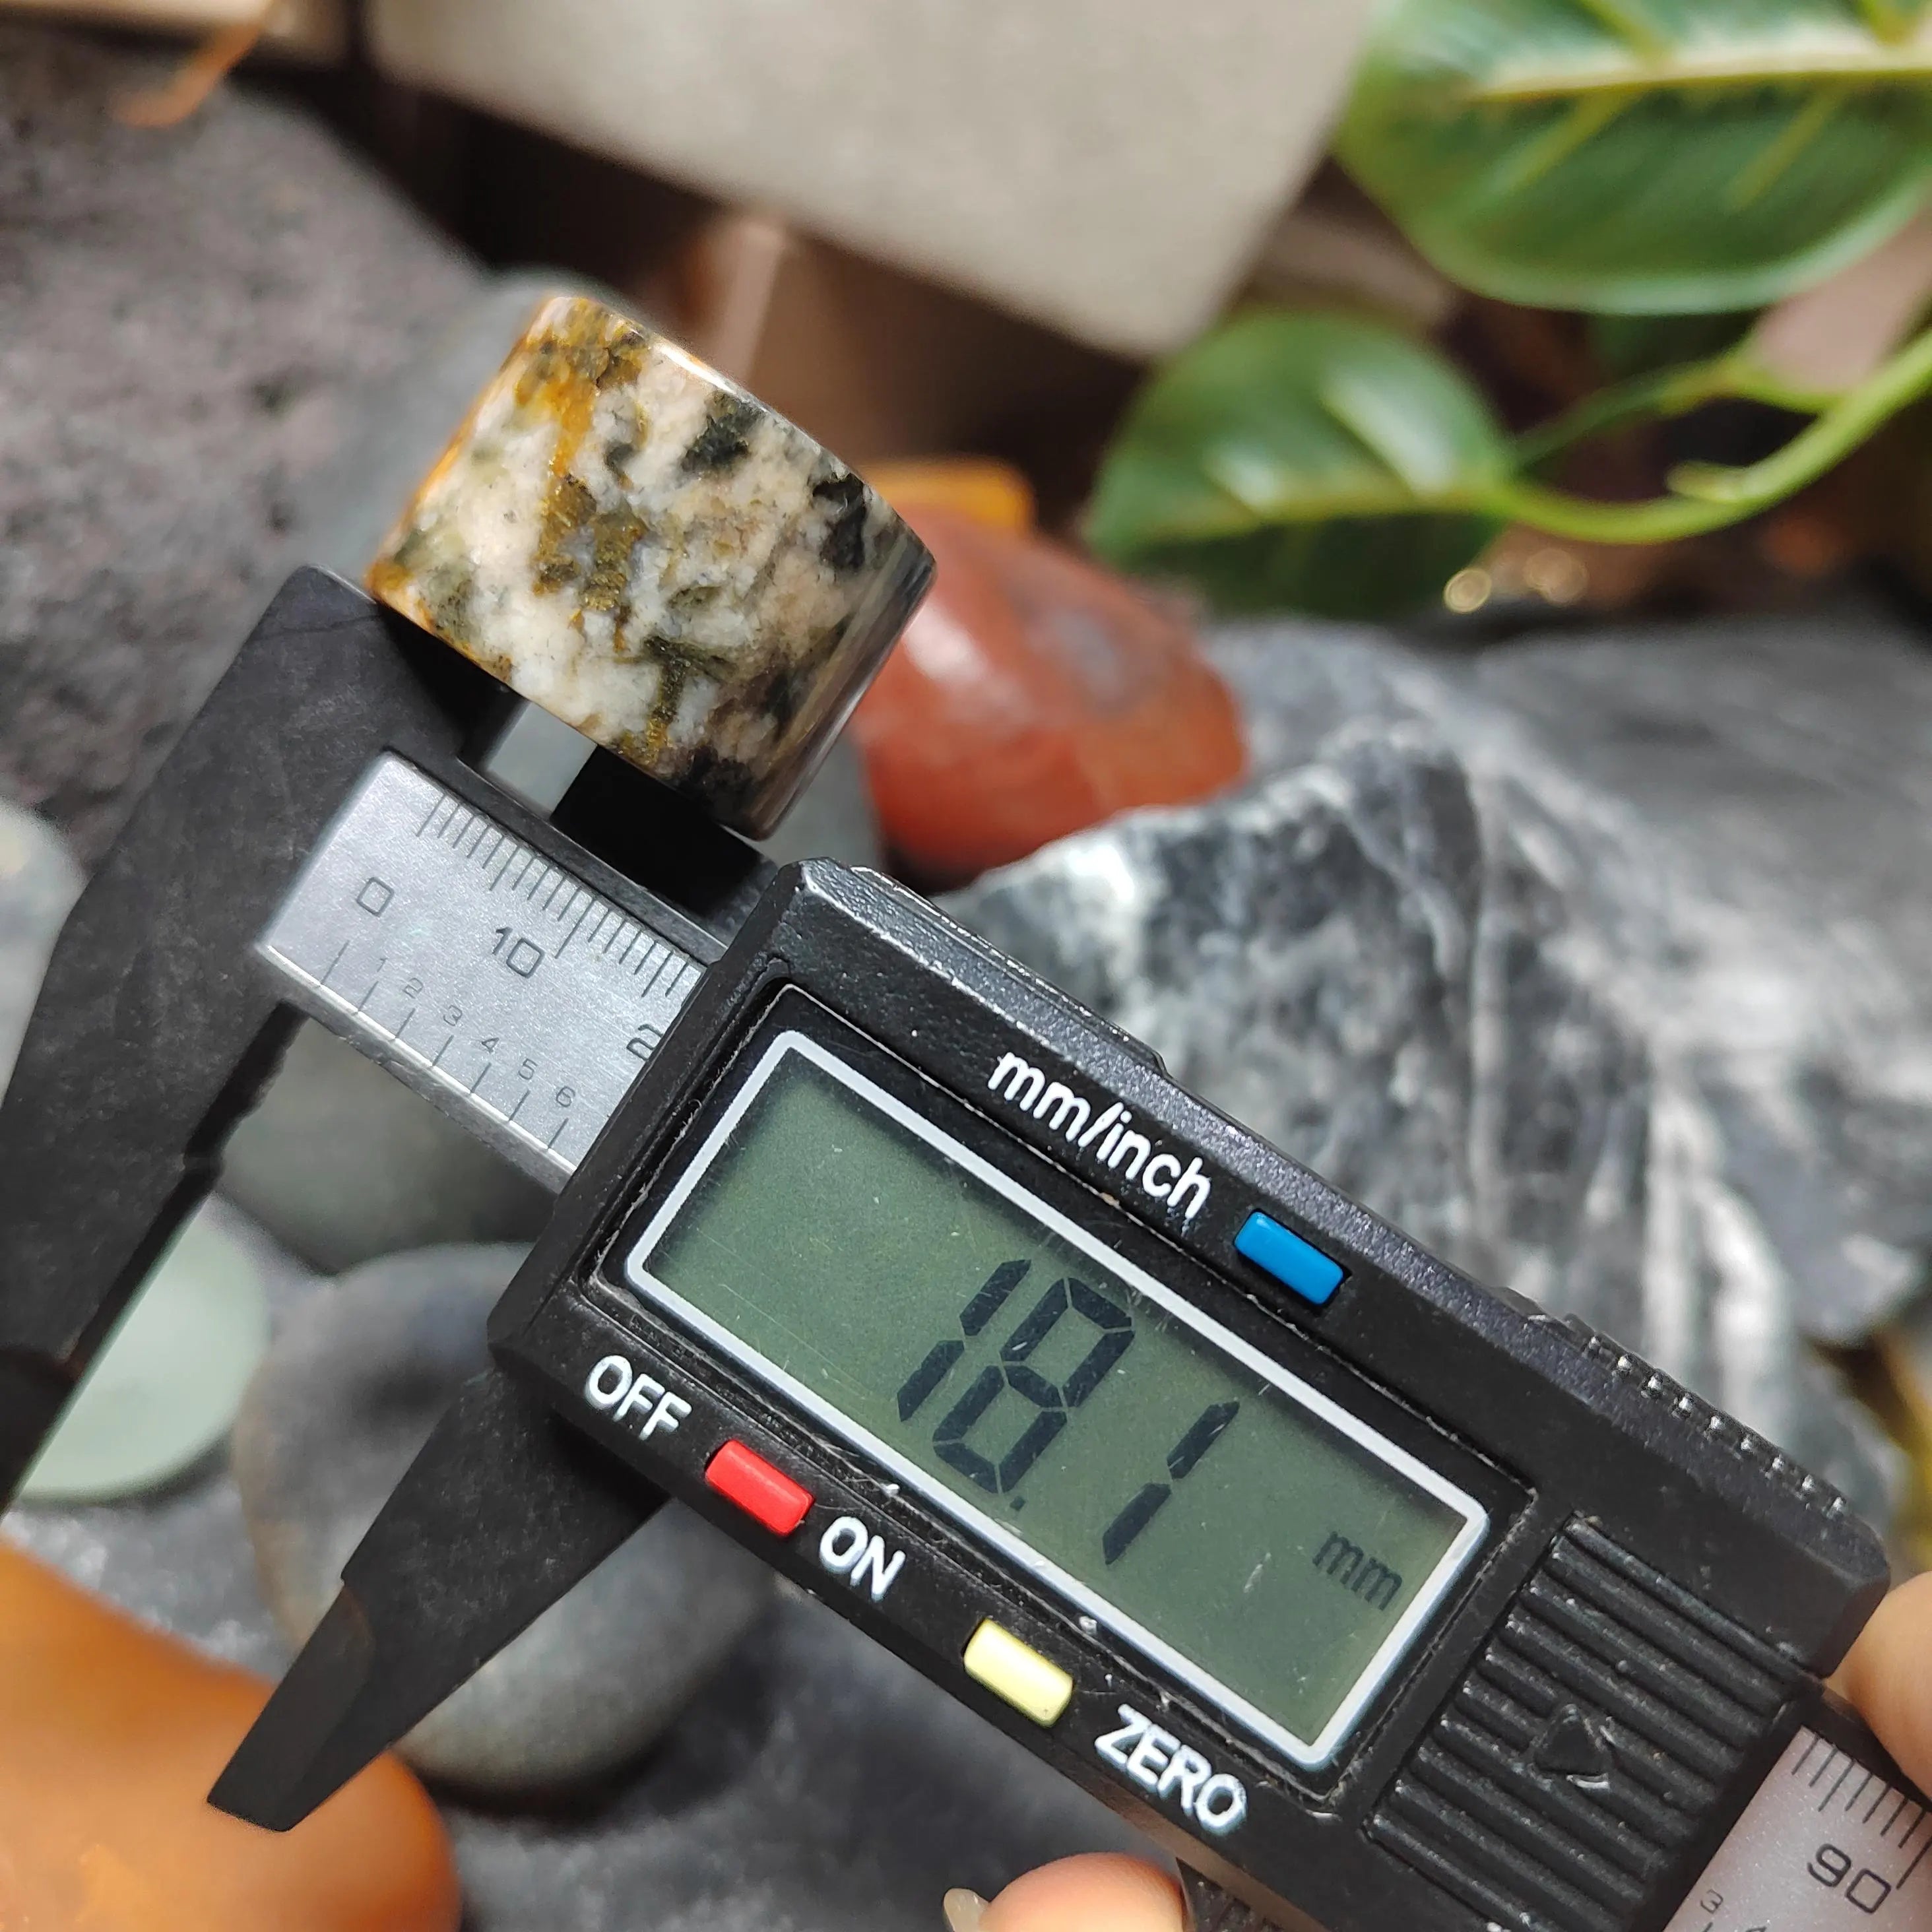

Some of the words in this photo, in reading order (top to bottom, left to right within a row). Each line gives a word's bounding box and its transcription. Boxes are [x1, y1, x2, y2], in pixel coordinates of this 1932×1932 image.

[356, 876, 395, 917] 0
[492, 926, 546, 979] 10
[379, 956, 389, 973] 1
[401, 977, 424, 1000] 2
[443, 1004, 463, 1027] 3
[480, 1037, 499, 1055] 4
[517, 1058, 538, 1081] 5
[555, 1085, 576, 1109] 6
[988, 1052, 1211, 1219] mm/inch
[585, 1355, 693, 1441] OFF
[897, 1258, 1240, 1565] 18.1
[1312, 1531, 1403, 1611] mm
[819, 1516, 906, 1601] ON
[1094, 1703, 1248, 1836] ZERO
[1700, 1888, 1723, 1914] 3
[1807, 1843, 1892, 1914] 90
